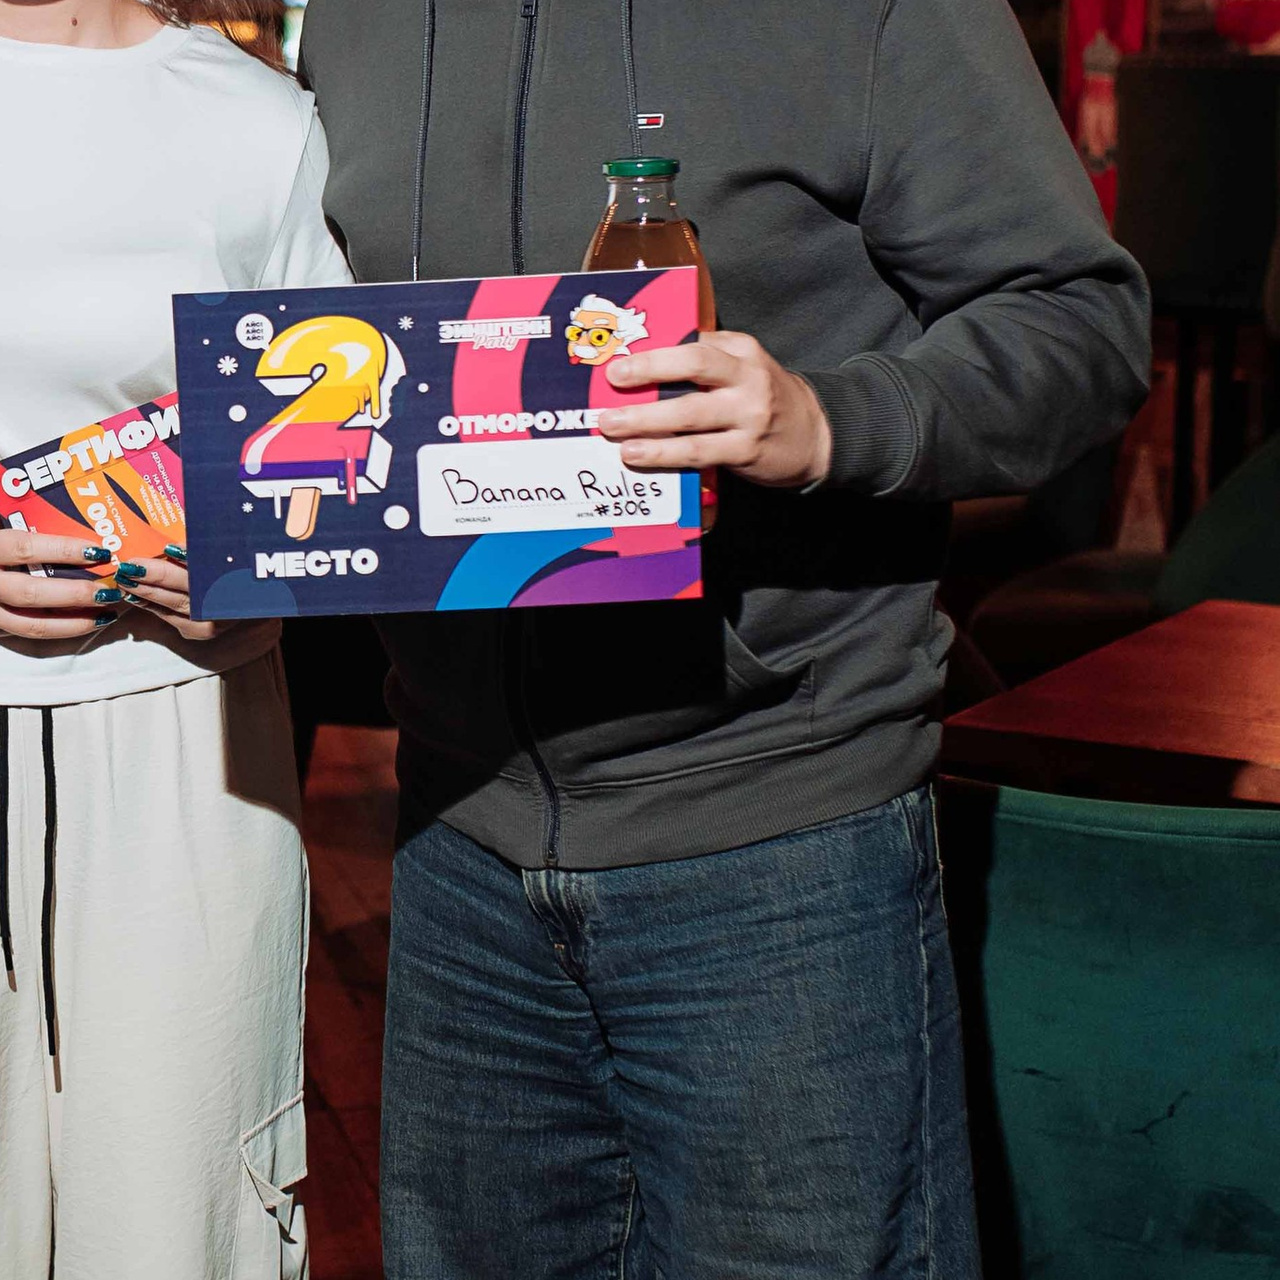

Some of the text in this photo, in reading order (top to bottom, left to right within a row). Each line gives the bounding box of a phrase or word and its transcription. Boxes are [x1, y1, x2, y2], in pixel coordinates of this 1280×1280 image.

[239, 315, 407, 499] 2
[438, 408, 606, 437] ОТМОРОЖЕ
[1, 404, 181, 498] СЕРТИФИ
[76, 480, 100, 497] 7
[105, 494, 115, 508] НА
[441, 468, 663, 505] Banana Rules
[594, 500, 651, 517] #506
[87, 502, 123, 553] 000
[255, 548, 380, 580] МЕСТО
